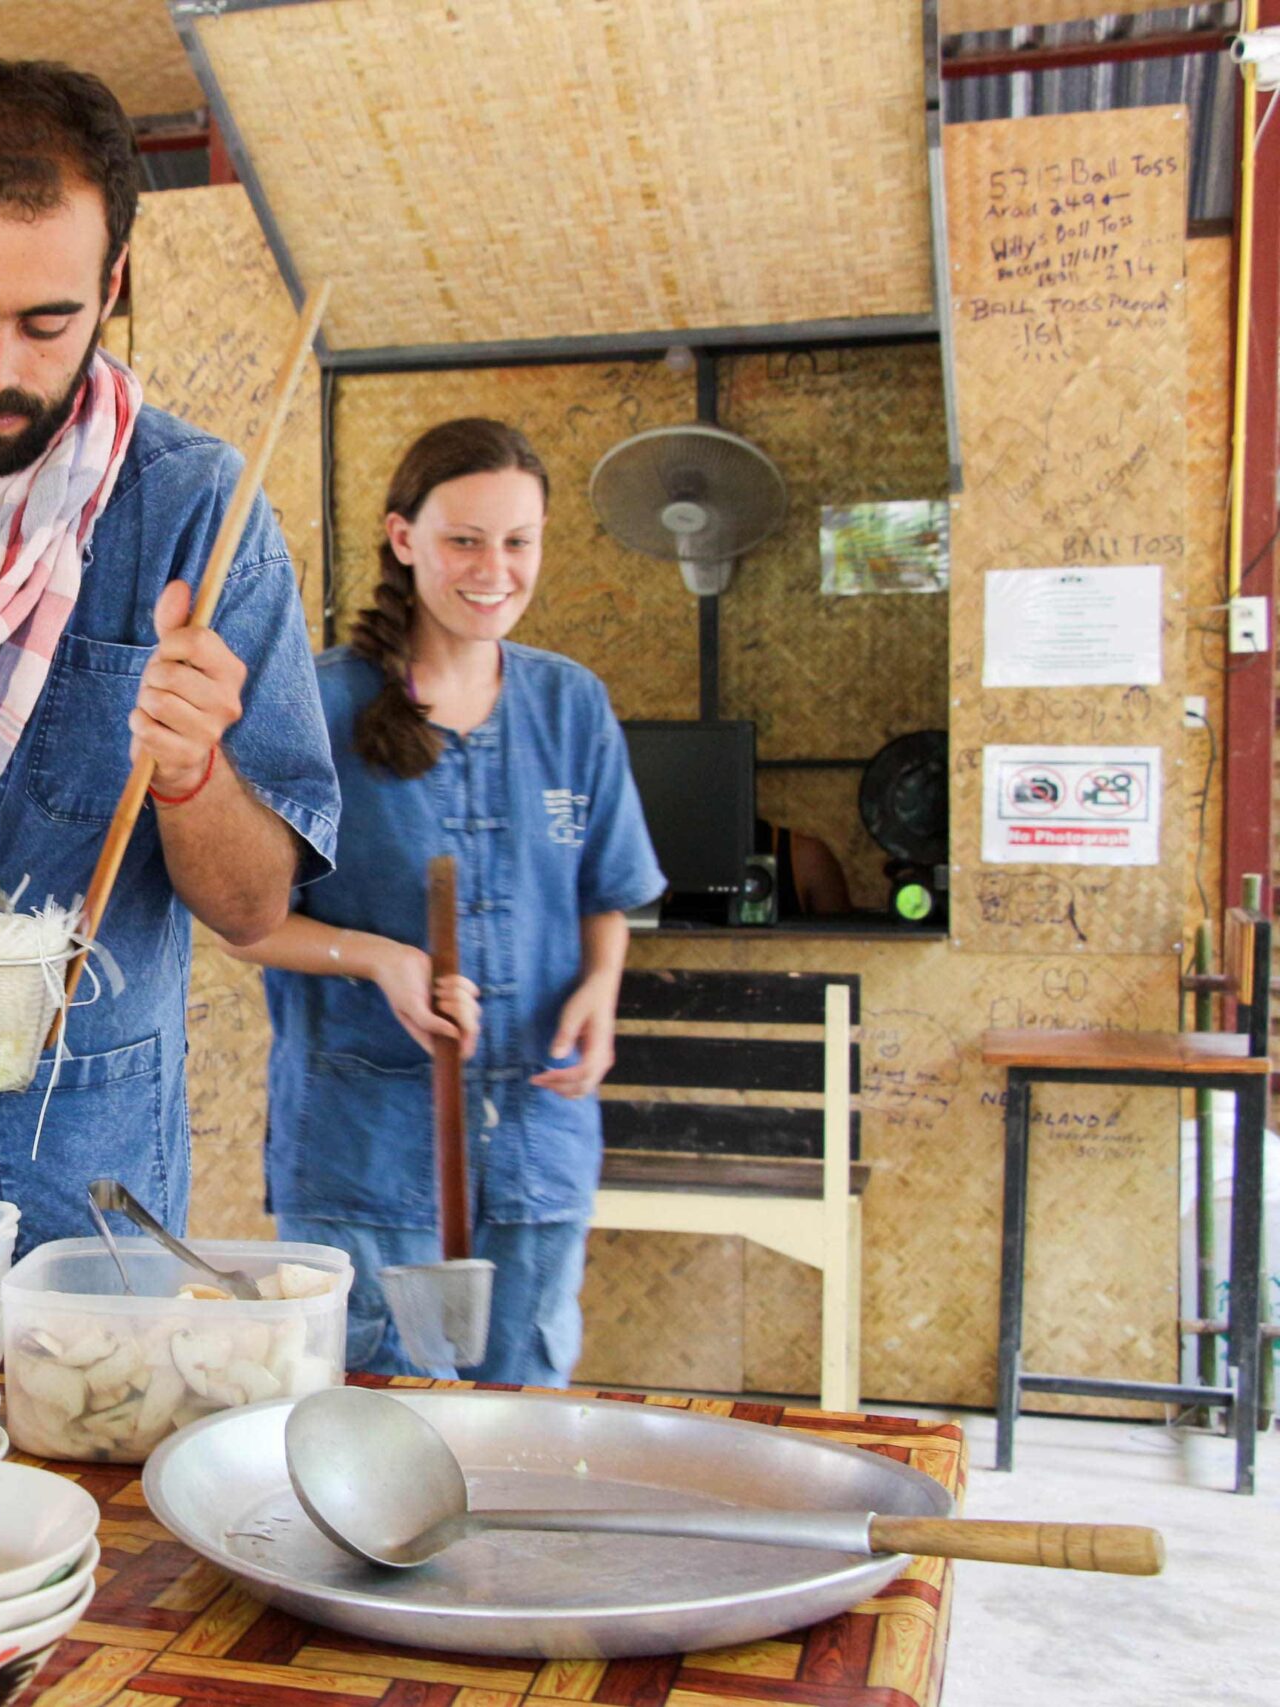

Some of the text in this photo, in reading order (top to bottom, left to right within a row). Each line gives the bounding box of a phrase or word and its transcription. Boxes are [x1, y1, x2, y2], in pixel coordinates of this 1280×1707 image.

[1071, 157, 1116, 185] Ball
[1131, 154, 1177, 176] Toss
[1010, 829, 1129, 847] No Photograph
